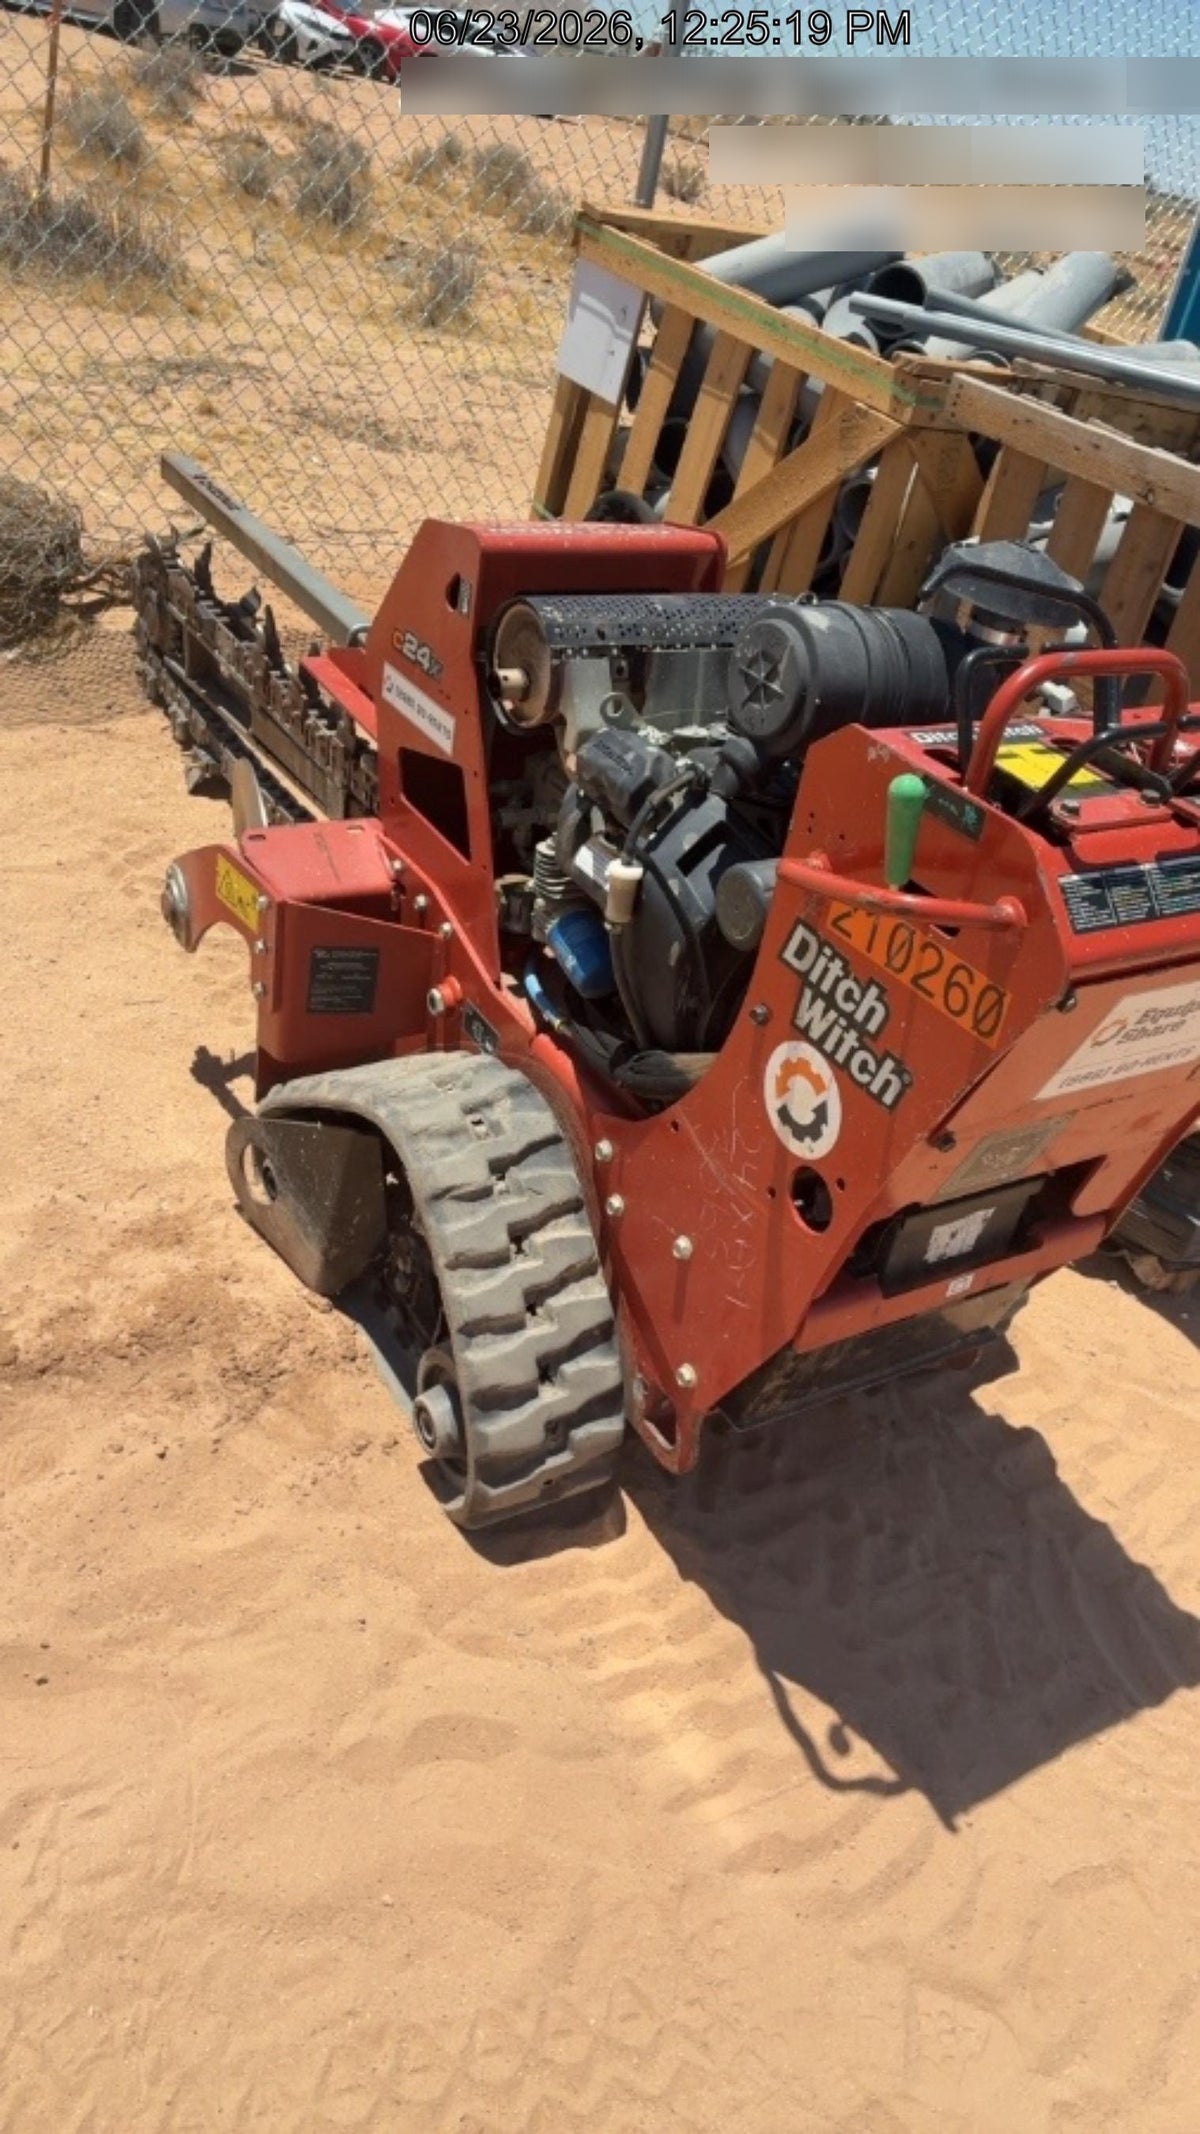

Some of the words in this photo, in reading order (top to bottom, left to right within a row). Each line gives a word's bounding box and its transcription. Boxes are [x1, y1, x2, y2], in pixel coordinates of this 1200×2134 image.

[781, 923, 887, 1035] Ditch
[829, 905, 1007, 1039] 210260
[794, 985, 904, 1107] Witch
